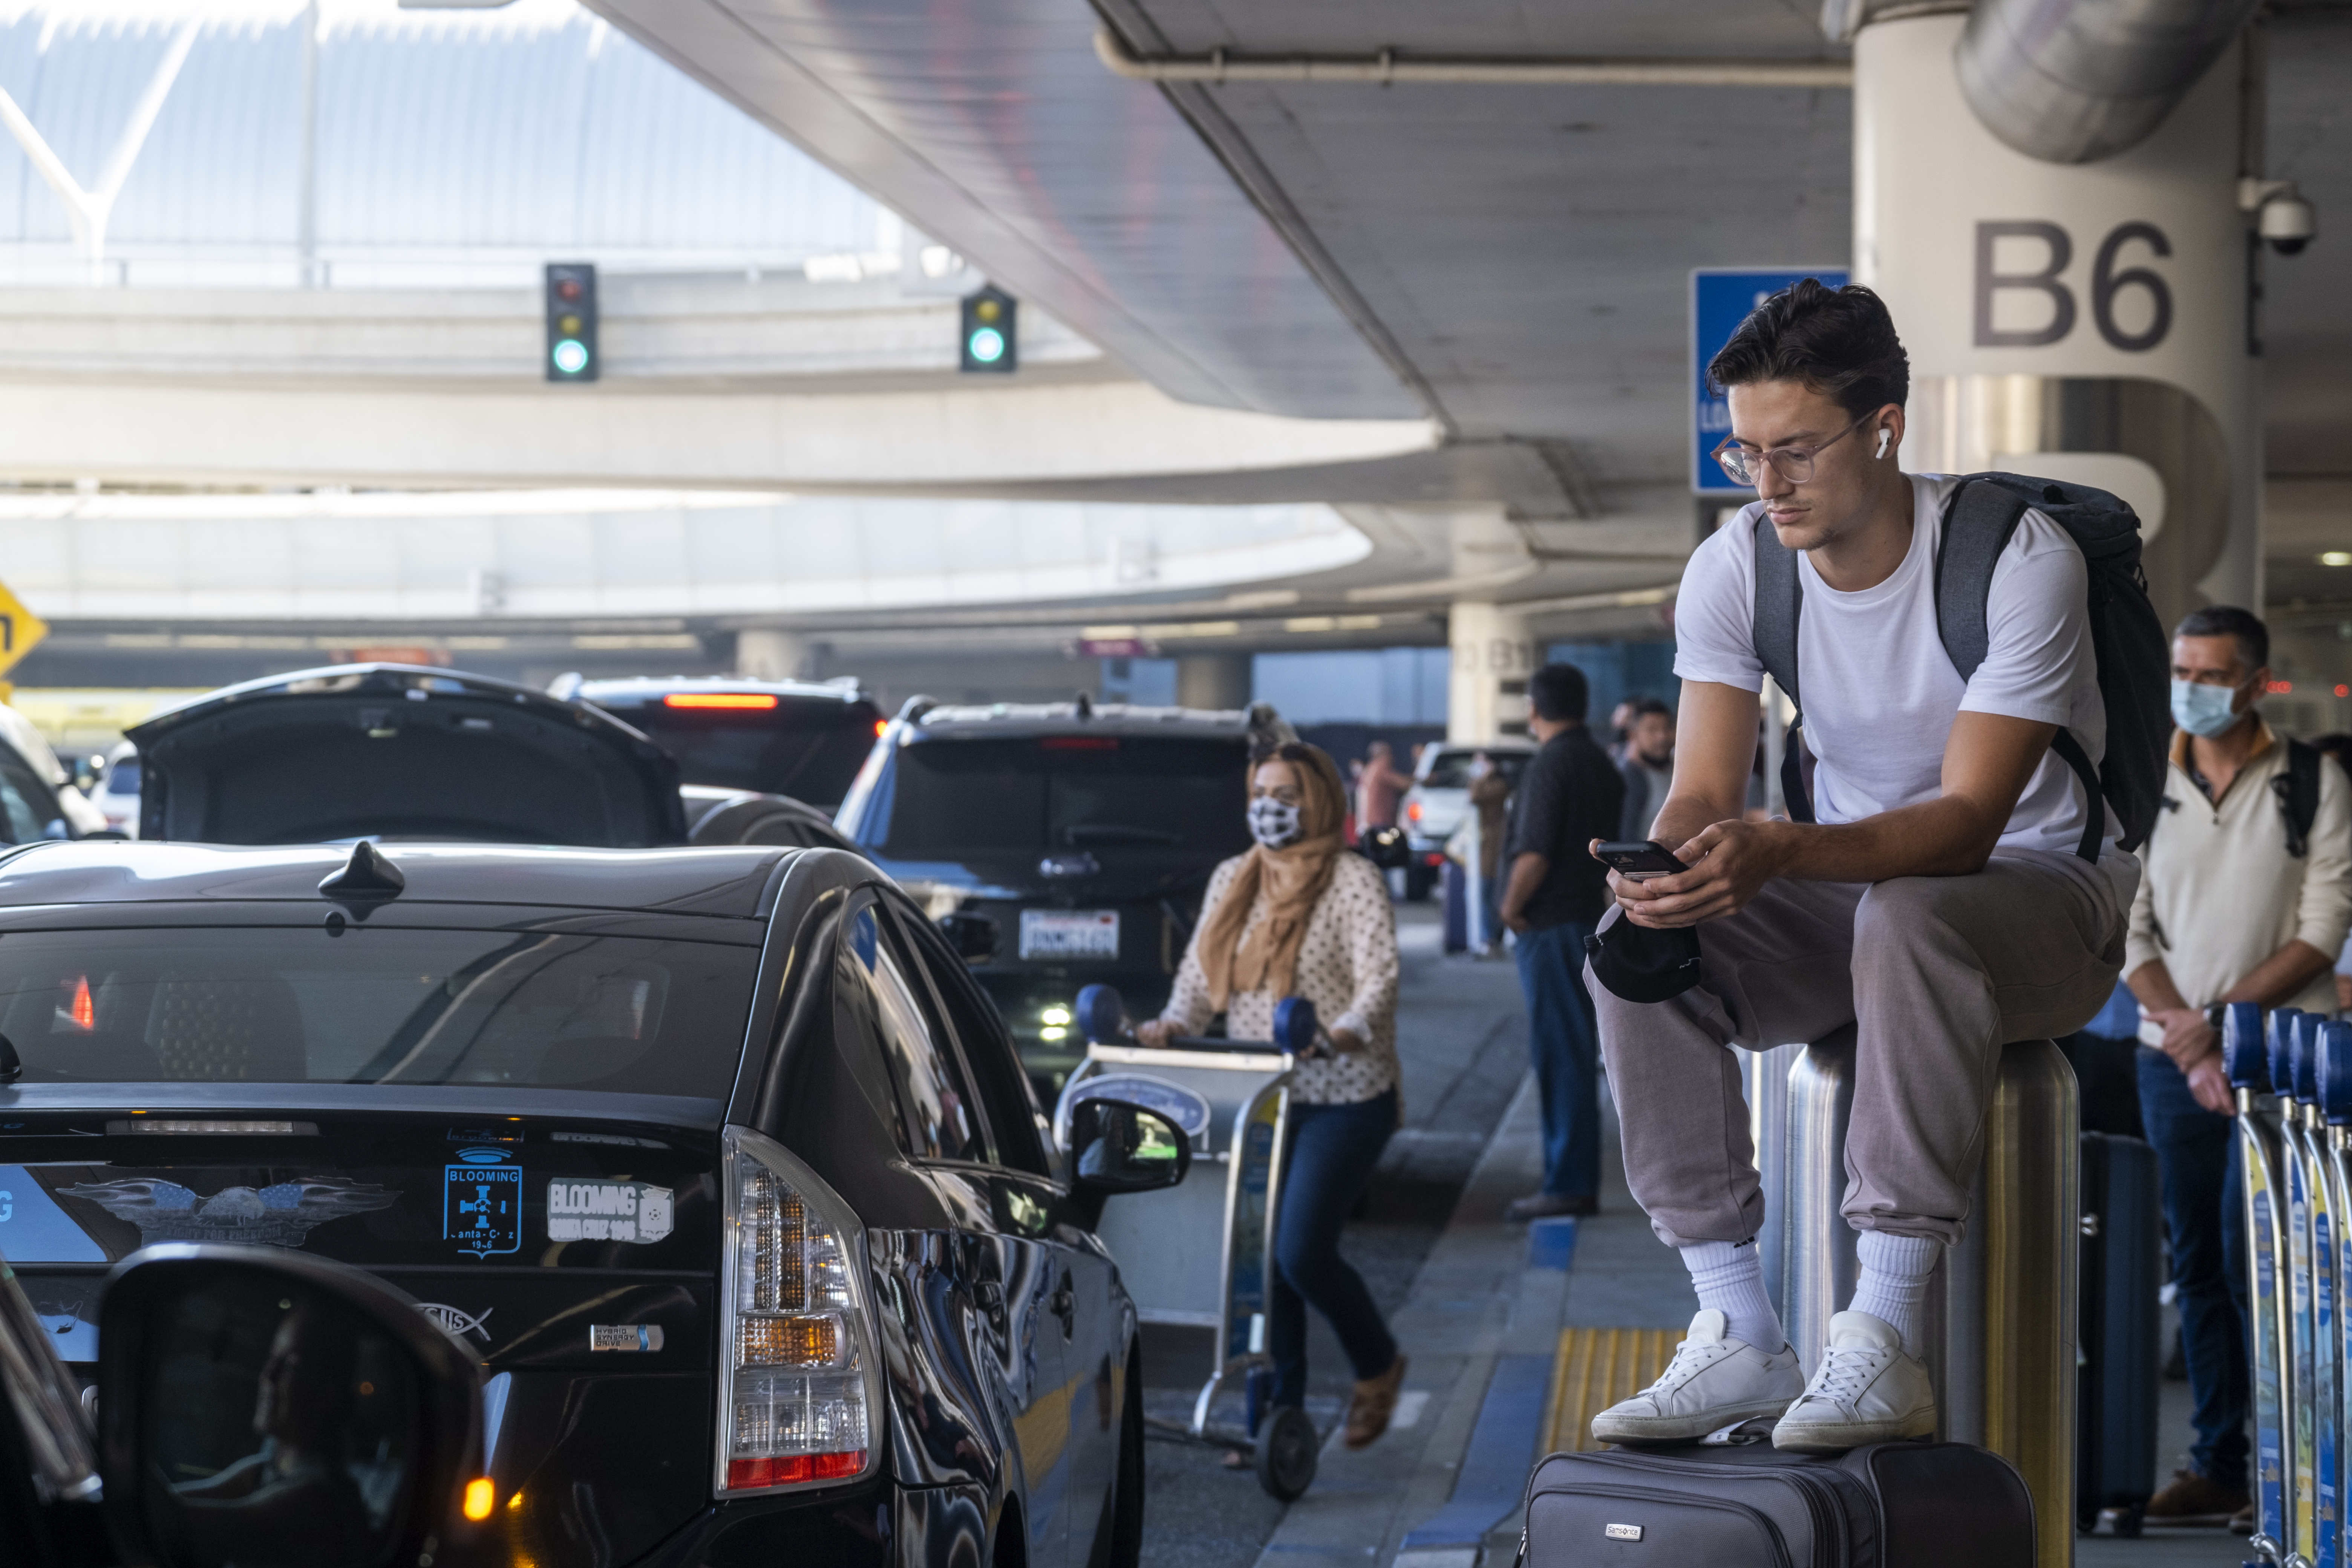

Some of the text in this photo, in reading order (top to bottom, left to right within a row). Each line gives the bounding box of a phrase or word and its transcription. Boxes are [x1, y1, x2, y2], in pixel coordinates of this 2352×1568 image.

[1974, 220, 2172, 352] B6
[450, 1170, 518, 1182] BLOOMING
[550, 1184, 636, 1216] BLOOMING
[1608, 1527, 1638, 1535] Samsonite
